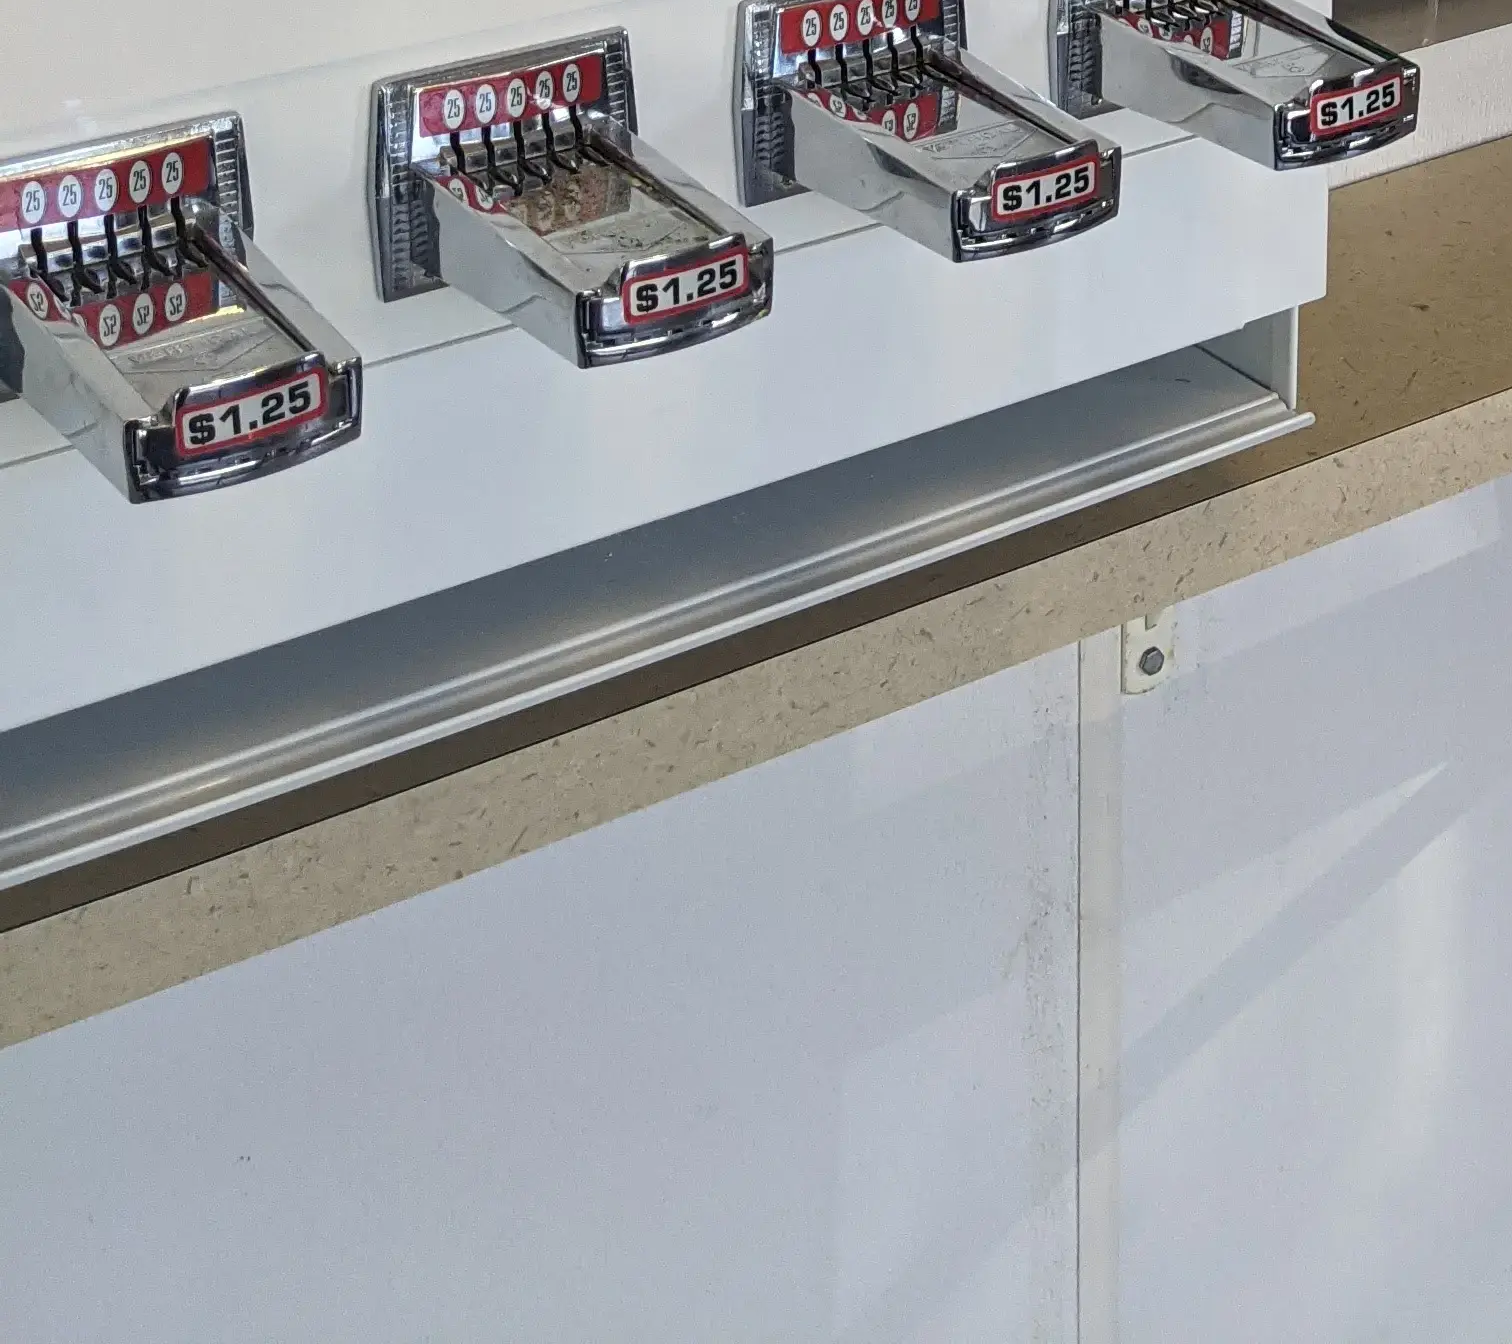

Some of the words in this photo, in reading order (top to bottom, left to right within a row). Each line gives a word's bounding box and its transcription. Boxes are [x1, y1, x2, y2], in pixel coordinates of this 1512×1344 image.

[805, 17, 818, 37] 25
[833, 11, 845, 32] 25
[860, 5, 872, 25] 25
[884, 0, 895, 20] 25
[447, 97, 462, 120] 25
[478, 91, 493, 114] 25
[510, 84, 523, 107] 25
[539, 78, 552, 100] 25
[566, 71, 578, 93] 25
[1319, 81, 1396, 128] $1.25
[25, 189, 41, 214] 25
[62, 182, 78, 208] 25
[98, 175, 114, 202] 25
[133, 168, 147, 193] 25
[166, 160, 180, 185] 25
[1001, 165, 1090, 212] $1.25
[635, 259, 739, 313] $1.25
[187, 381, 313, 446] $1.25
